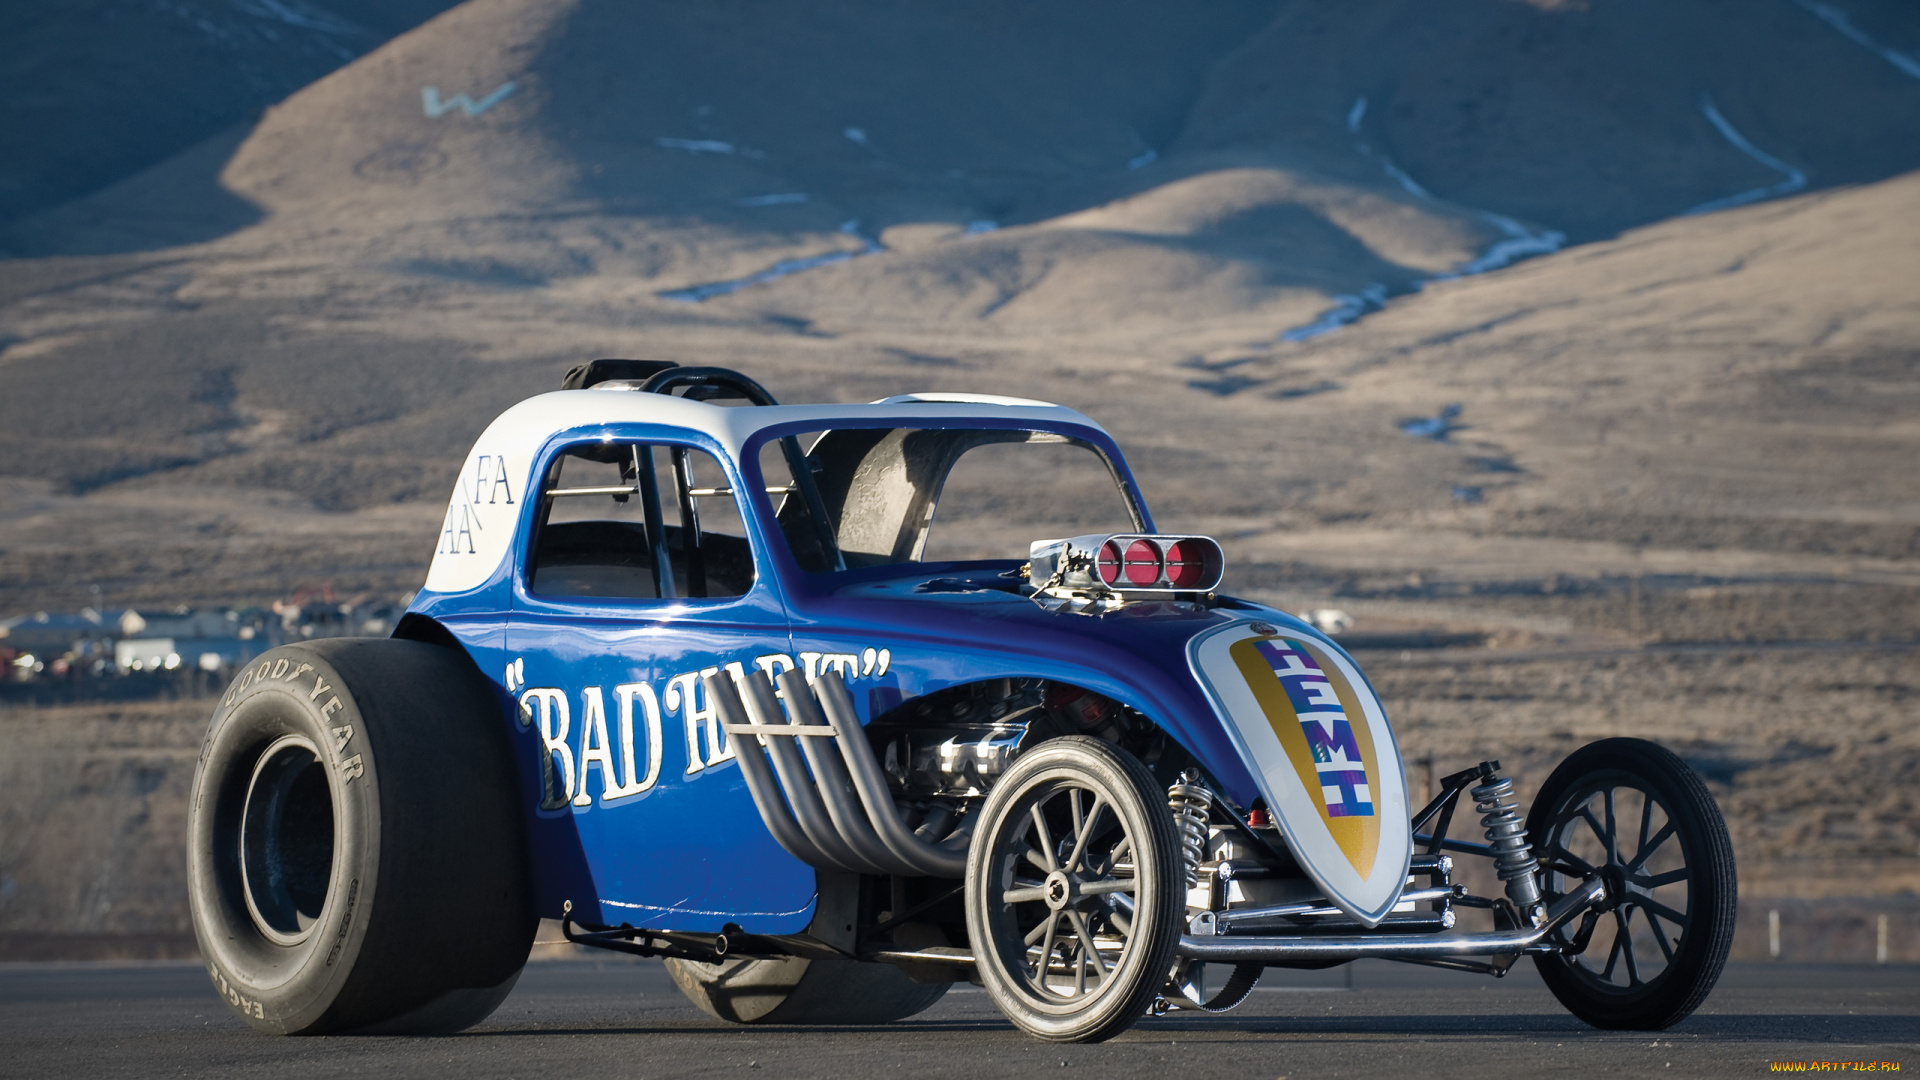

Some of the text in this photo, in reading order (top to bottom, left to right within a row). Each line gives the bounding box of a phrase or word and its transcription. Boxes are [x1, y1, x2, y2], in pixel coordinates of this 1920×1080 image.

[474, 454, 515, 504] FA
[439, 504, 476, 554] AA
[1252, 639, 1375, 818] HEMI
